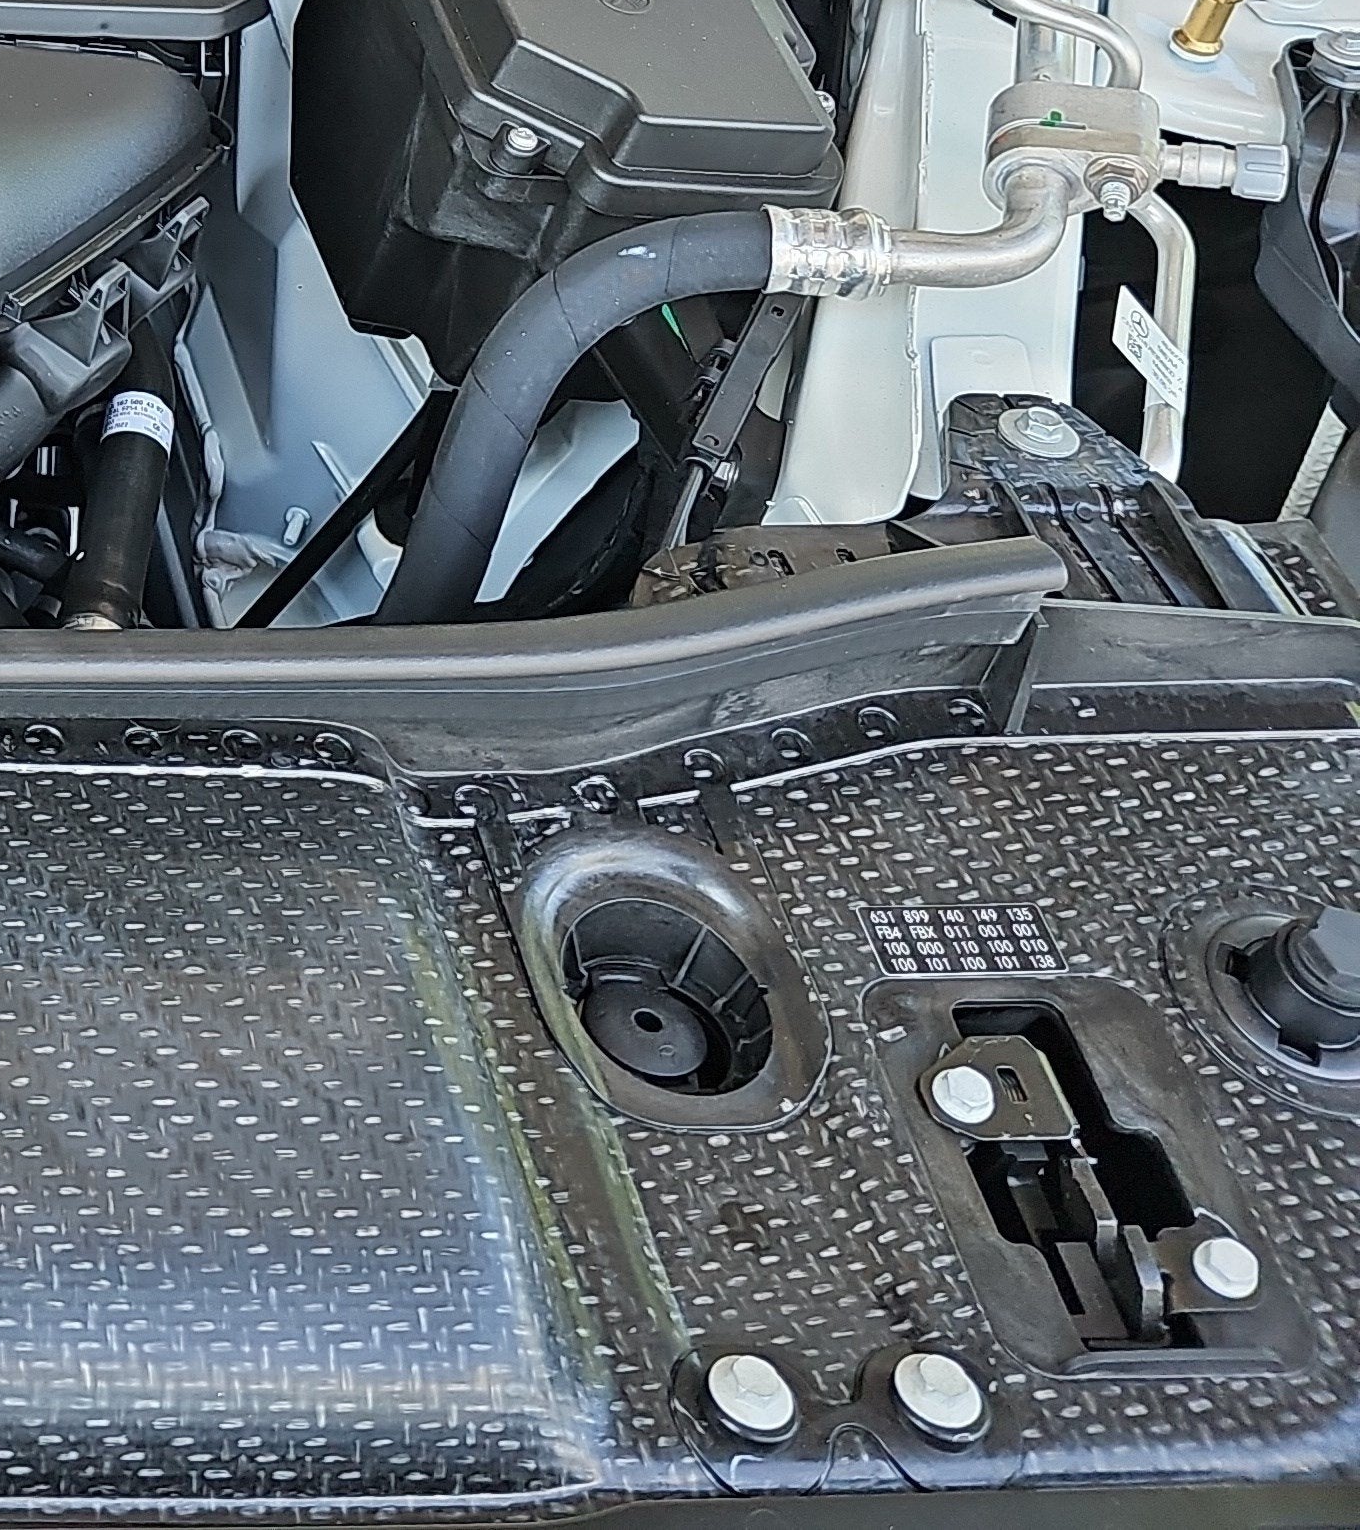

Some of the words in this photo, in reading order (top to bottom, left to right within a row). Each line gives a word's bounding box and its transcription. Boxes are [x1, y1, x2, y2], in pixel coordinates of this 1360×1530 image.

[870, 910, 895, 923] 631
[903, 910, 929, 923] 899
[938, 910, 964, 923] 140
[972, 909, 997, 922] 149
[1006, 907, 1033, 921] 135
[875, 925, 902, 939] FB4
[909, 925, 938, 939] FBX
[944, 925, 971, 938] 011
[978, 924, 1005, 937] 001
[1013, 924, 1040, 937] 001
[884, 942, 910, 955] 100
[917, 942, 945, 955] 000
[953, 941, 979, 954] 110
[987, 940, 1014, 953] 100
[1020, 939, 1049, 953] 010
[891, 958, 917, 971] 100
[925, 958, 951, 971] 101
[960, 957, 987, 970] 100
[994, 956, 1020, 969] 101
[1029, 955, 1056, 968] 138
